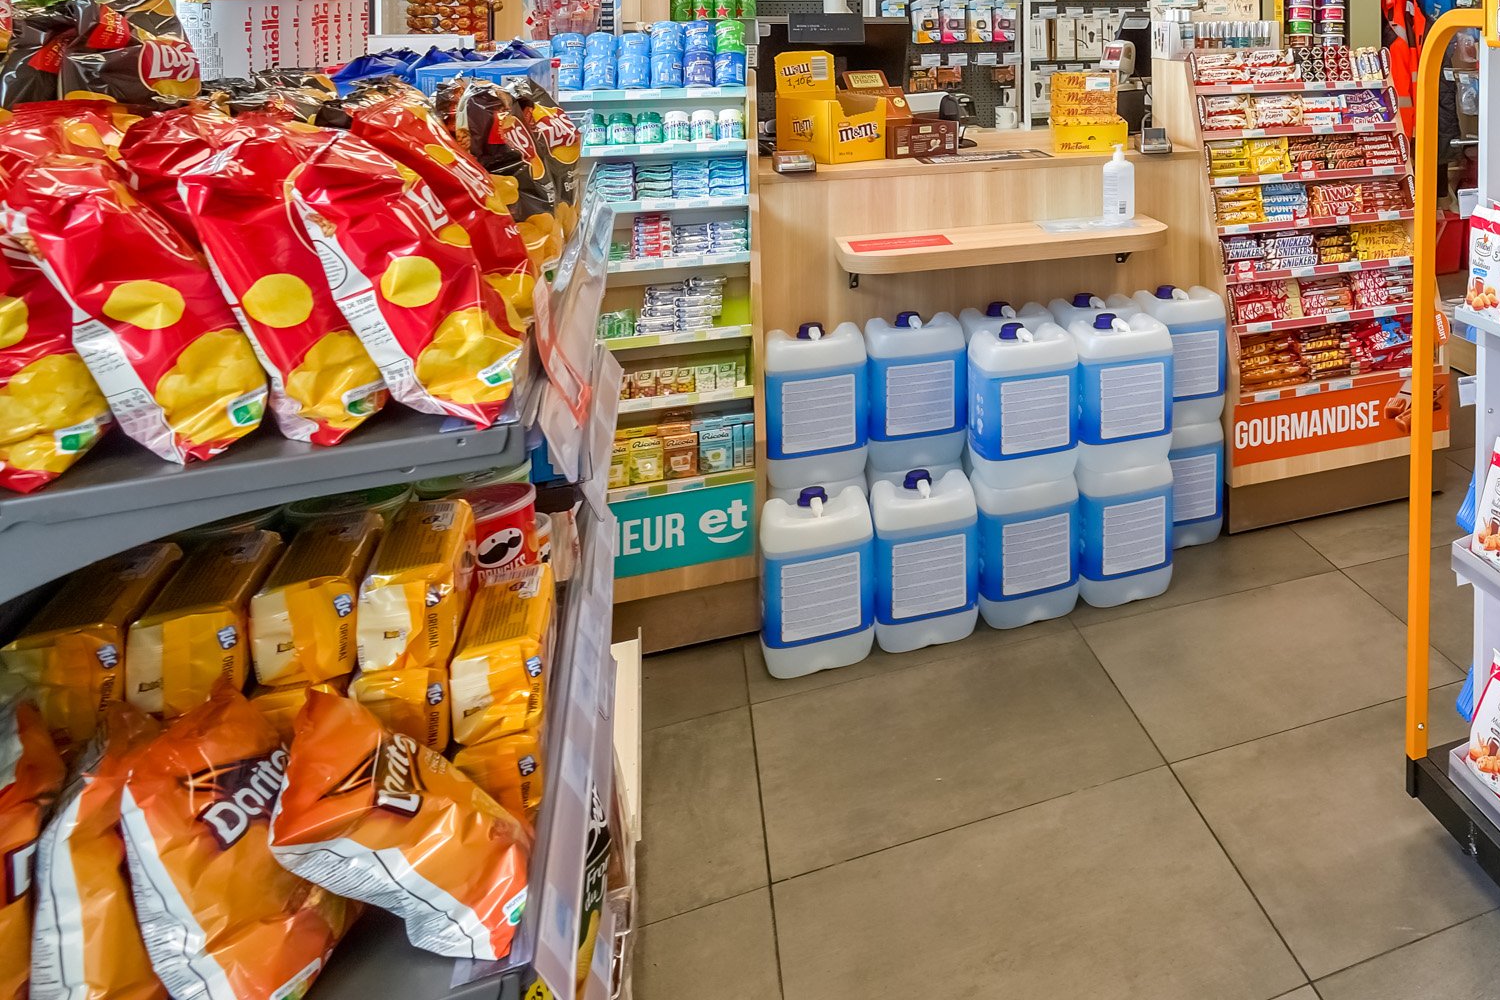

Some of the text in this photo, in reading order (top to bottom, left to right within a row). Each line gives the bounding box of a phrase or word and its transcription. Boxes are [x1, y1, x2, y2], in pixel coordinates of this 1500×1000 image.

[272, 5, 280, 69] nutella
[1254, 52, 1275, 63] bueno
[1260, 69, 1282, 79] bueno
[1350, 102, 1379, 114] CRUNCH
[1276, 235, 1312, 248] SNICKERS
[1229, 249, 1264, 258] SNICKERS
[1277, 247, 1312, 257] SNICKERS
[1282, 255, 1317, 267] SNICKERS
[1434, 314, 1447, 341] BISCUIT
[1234, 400, 1380, 450] GOURMANDISE
[632, 439, 661, 449] Ricola
[665, 437, 694, 448] Ricola
[701, 431, 730, 441] Ricola
[698, 499, 748, 535] et
[333, 594, 353, 618] TUC
[218, 626, 236, 651] TUC
[427, 613, 440, 650] ORIGINAL
[338, 623, 349, 662] ORIGINAL
[97, 644, 118, 668] TUC
[527, 656, 541, 676] TUC
[427, 682, 443, 706] TUC
[520, 755, 535, 776] TUC
